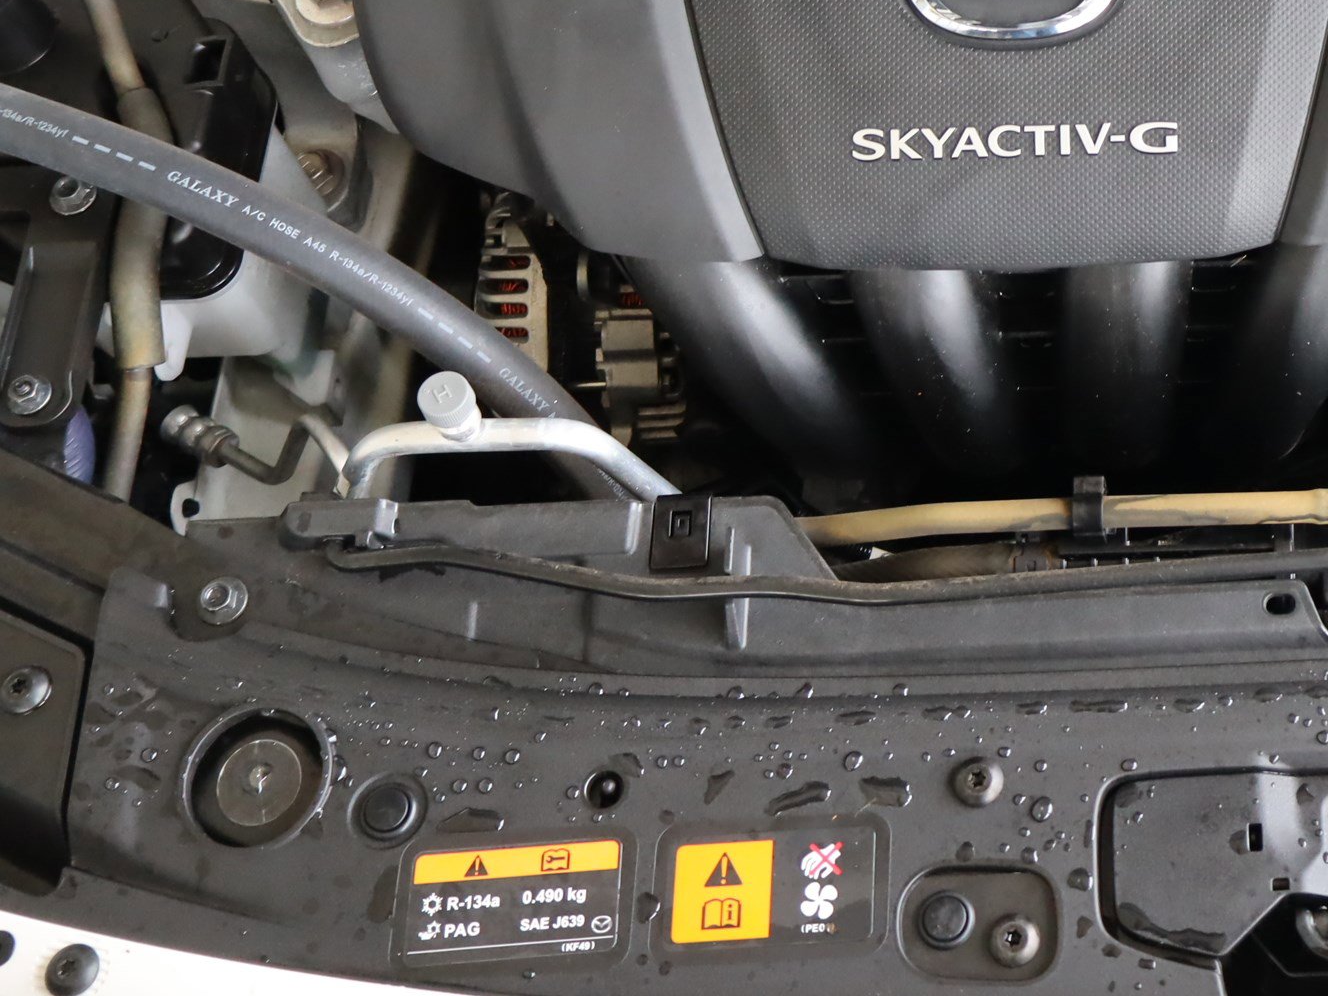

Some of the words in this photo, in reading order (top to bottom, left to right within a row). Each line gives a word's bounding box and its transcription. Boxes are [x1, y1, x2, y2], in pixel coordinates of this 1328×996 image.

[851, 121, 1179, 162] SKYACTIV-G
[167, 170, 240, 209] GALAXY
[241, 204, 267, 222] A/C
[269, 217, 302, 240] HOSE
[498, 366, 551, 412] GALAXY
[446, 893, 501, 911] R-134a
[521, 889, 564, 905] 0.490
[566, 887, 588, 905] kg
[443, 921, 482, 939] PAG
[519, 916, 550, 933] SAE
[552, 914, 586, 930] J639
